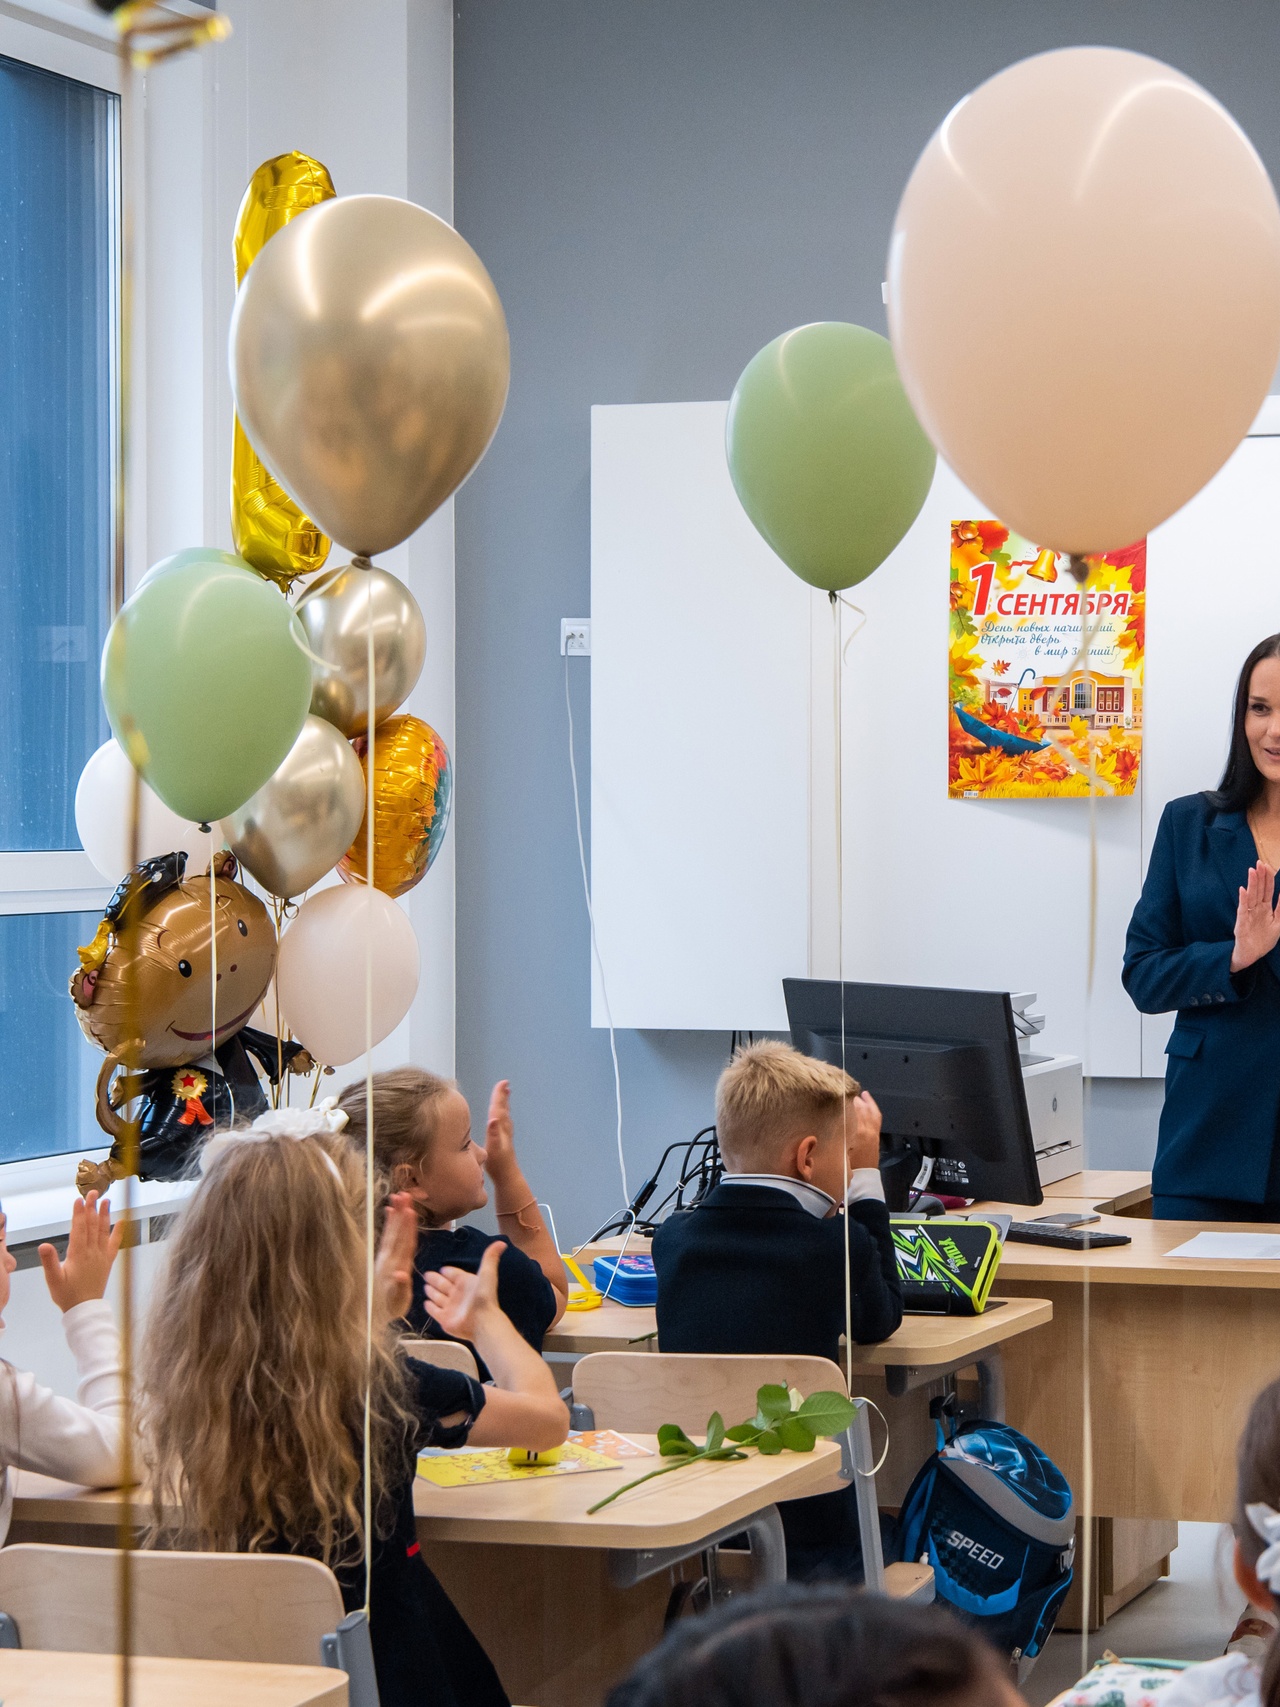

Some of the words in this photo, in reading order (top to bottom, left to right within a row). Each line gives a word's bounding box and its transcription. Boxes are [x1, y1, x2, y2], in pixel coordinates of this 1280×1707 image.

[971, 563, 995, 616] 1
[997, 593, 1129, 616] СЕНТЯБРЯ
[981, 620, 1013, 633] День
[1016, 621, 1050, 633] новых
[980, 632, 1026, 648] Открыта
[1029, 632, 1060, 648] дверь
[1034, 644, 1042, 656] в
[1043, 646, 1068, 659] мир
[947, 1530, 1004, 1570] SPEED
